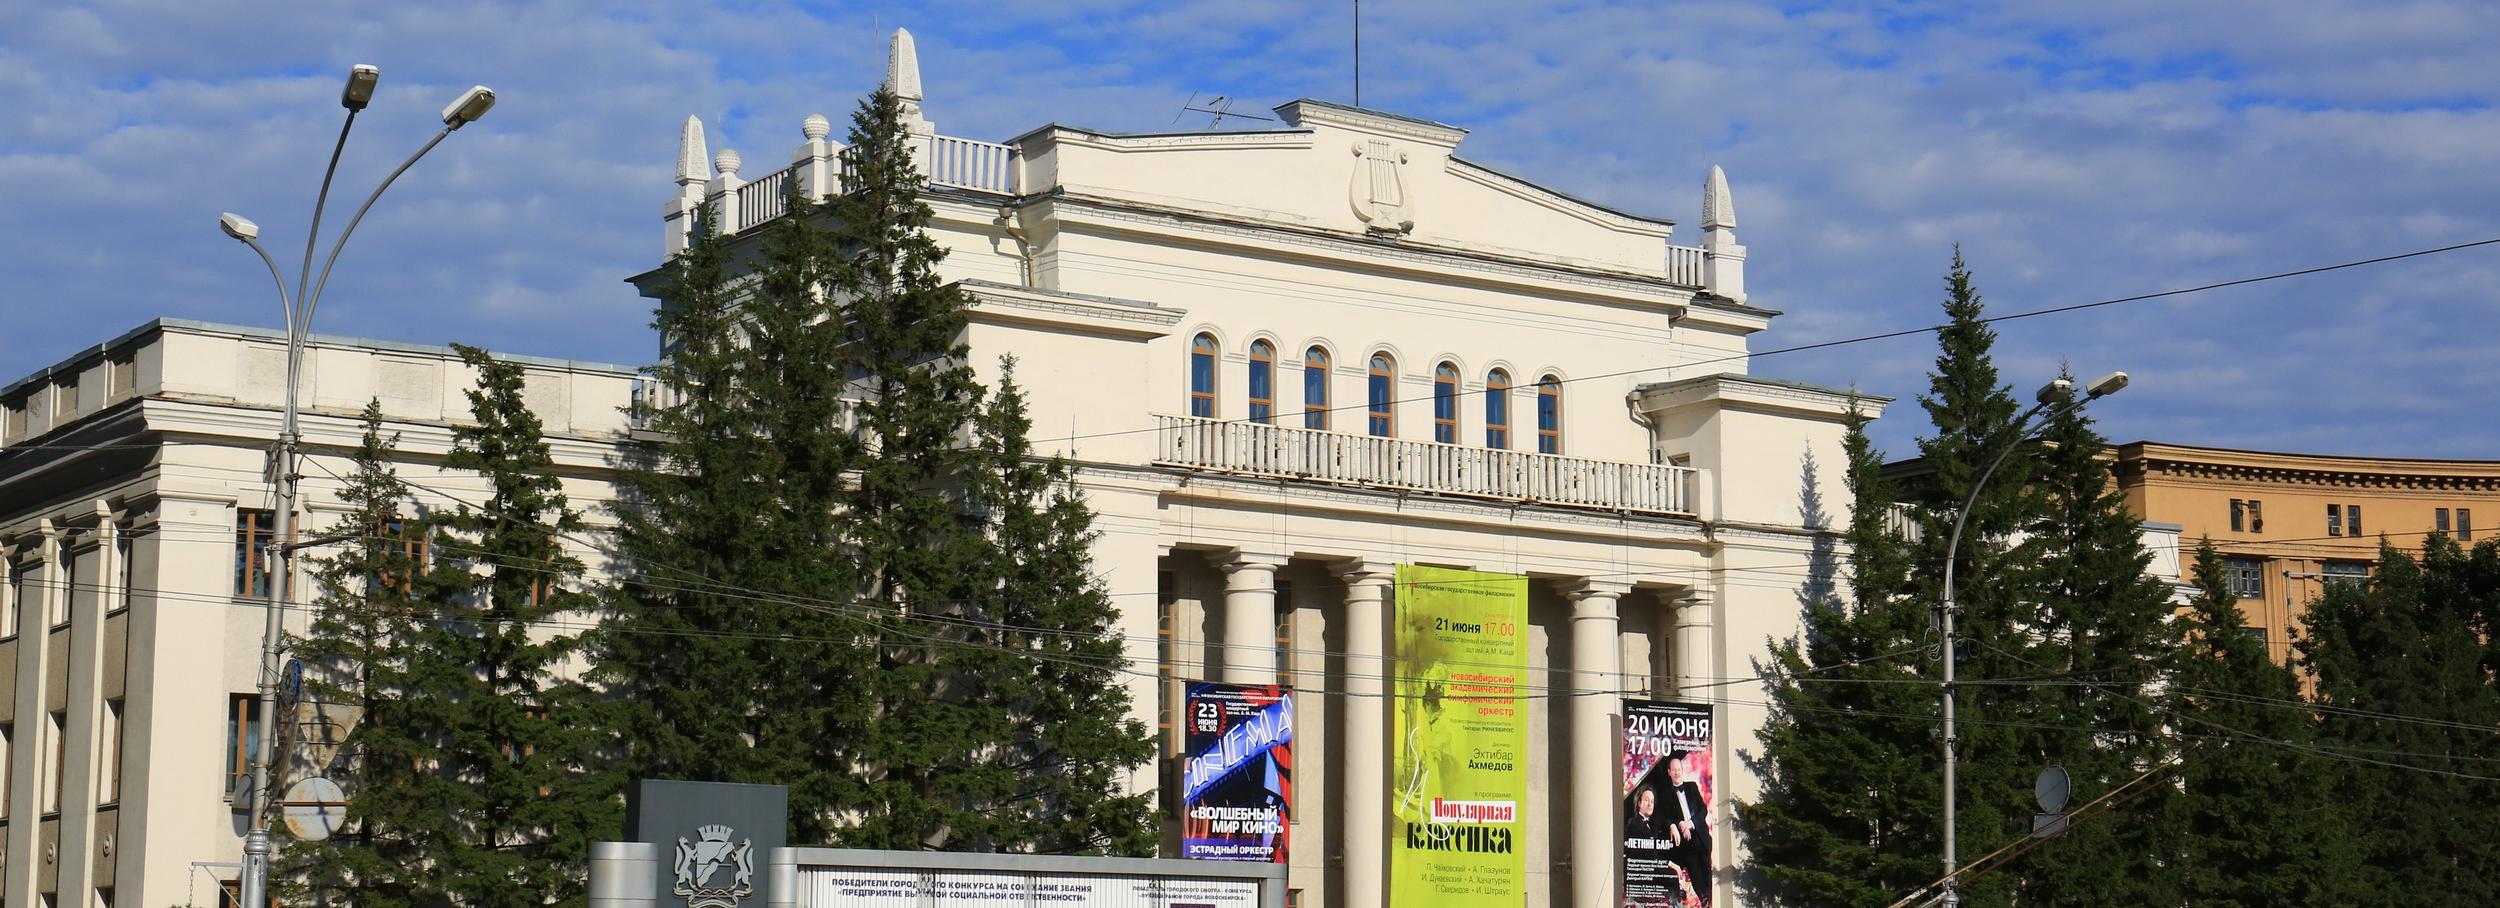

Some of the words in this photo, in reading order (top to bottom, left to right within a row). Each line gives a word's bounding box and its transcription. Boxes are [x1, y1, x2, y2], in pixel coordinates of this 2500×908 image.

[1435, 617, 1448, 631] 21
[1452, 622, 1481, 633] июня
[1484, 622, 1515, 636] 17.00
[1451, 672, 1515, 684] новосибирский
[1450, 684, 1515, 695] академический
[1198, 703, 1218, 718] 23
[1478, 707, 1514, 717] оркестр
[1628, 714, 1650, 735] 20
[1653, 716, 1710, 738] ИЮНЯ
[1628, 736, 1672, 757] 17.00
[1474, 748, 1513, 761] Эхтибар
[1468, 760, 1513, 771] Ахмедов
[1190, 805, 1278, 820] «ВОЛШЕБНЫЙ
[1434, 797, 1512, 824] Популярная
[1212, 820, 1240, 834] МИР
[1242, 821, 1285, 834] КИНО»
[1190, 845, 1238, 855] ЭСТРАДНЫЙ
[1239, 846, 1274, 855] ОРКЕСТР
[1624, 837, 1655, 849] «ЛЕТНИЙ
[1656, 839, 1674, 850] БАЛ»
[1480, 866, 1511, 875] Глазунов
[832, 878, 889, 888] ПОБЕДИТЕЛИ
[949, 881, 995, 891] КОНКУРСА
[997, 883, 1009, 891] НА
[1060, 884, 1092, 893] ЗВАНИЯ
[1484, 887, 1511, 896] Штраус
[838, 888, 903, 898] «ПРЕДПРИЯТИЕ
[949, 891, 1007, 900] СОЦИАЛЬНОЙ
